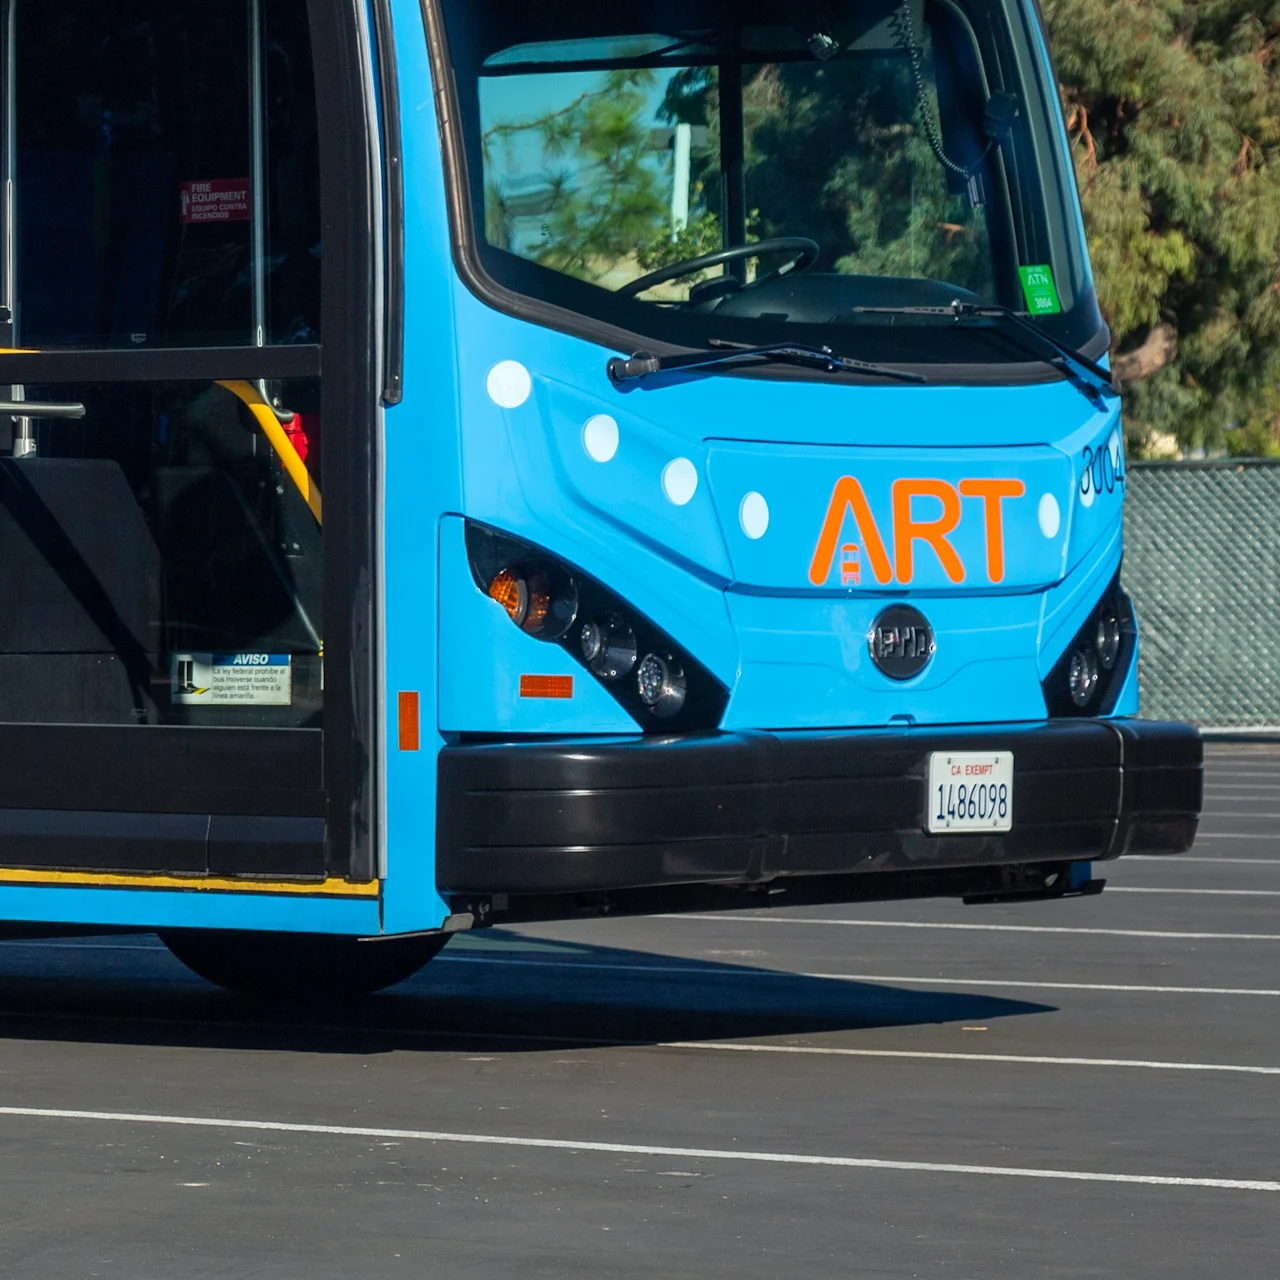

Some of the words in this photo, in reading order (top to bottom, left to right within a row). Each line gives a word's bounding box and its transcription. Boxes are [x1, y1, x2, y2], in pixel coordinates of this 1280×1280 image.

[191, 182, 212, 193] FIRE
[191, 190, 247, 203] EQUIPMENT
[191, 204, 218, 213] EQUIPO
[219, 202, 248, 211] CONTRA
[1027, 272, 1049, 286] ATN
[1080, 445, 1124, 495] 3004
[808, 475, 1025, 586] ART
[877, 626, 928, 658] BYD
[233, 654, 269, 665] AVISO
[222, 667, 231, 676] ley
[232, 667, 253, 675] federal
[253, 675, 277, 683] cuando
[213, 684, 236, 692] alguien
[251, 683, 269, 691] frente
[951, 765, 961, 776] CA
[965, 764, 993, 776] EXEMPT
[937, 783, 1007, 820] 1486098
